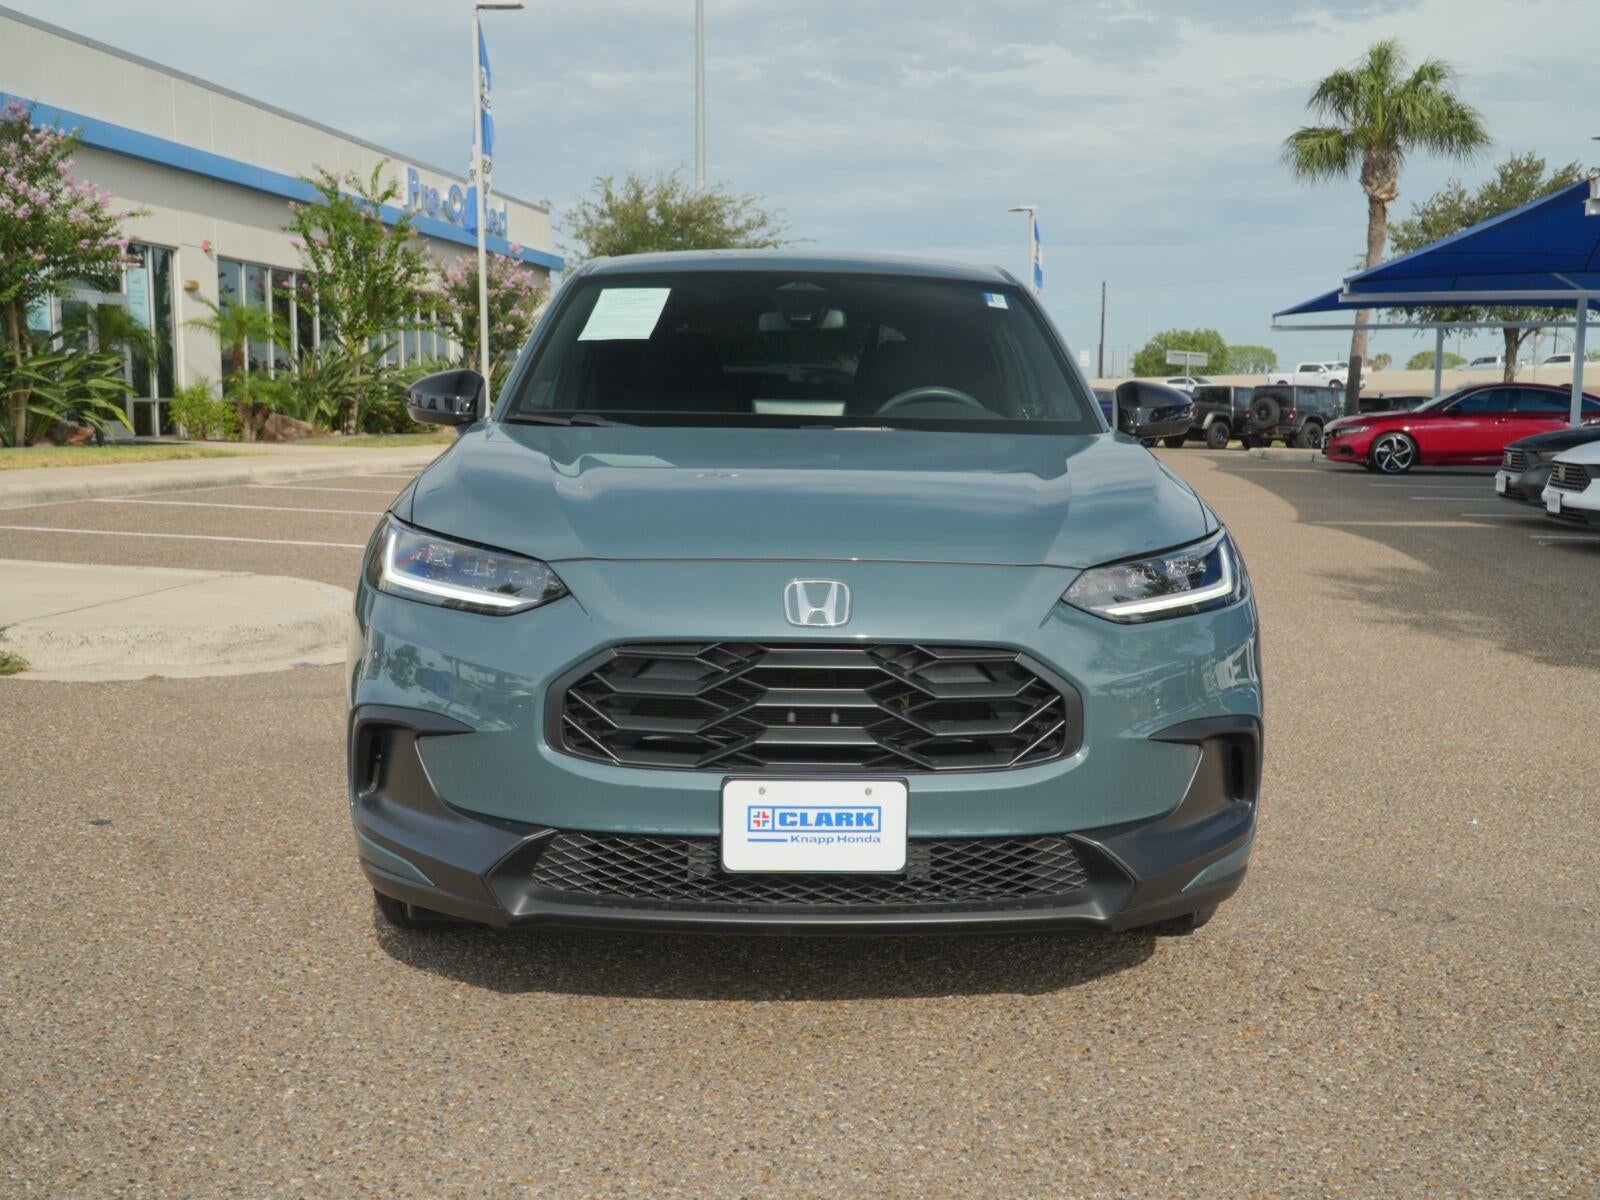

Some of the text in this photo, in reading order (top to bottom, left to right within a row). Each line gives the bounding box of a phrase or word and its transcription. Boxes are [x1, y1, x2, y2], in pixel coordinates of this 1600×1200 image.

[778, 811, 875, 827] CLARK
[790, 834, 881, 845] Knapp Honda
